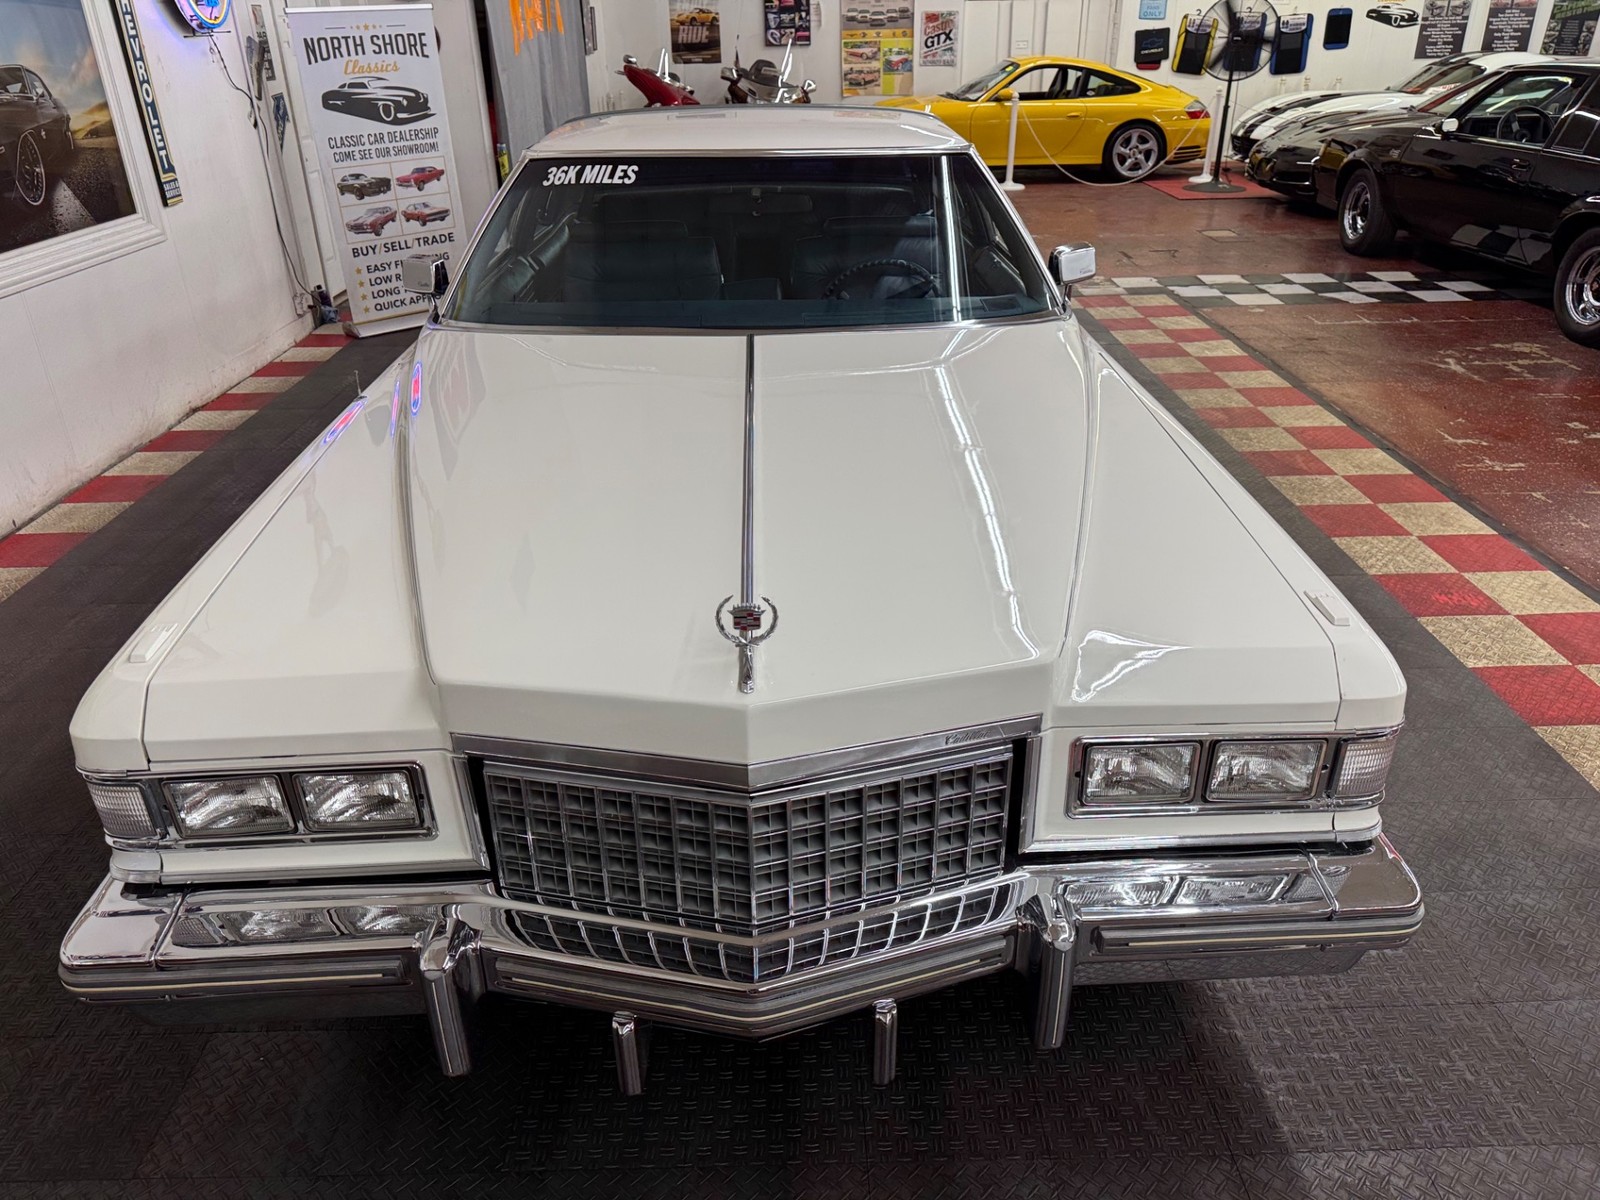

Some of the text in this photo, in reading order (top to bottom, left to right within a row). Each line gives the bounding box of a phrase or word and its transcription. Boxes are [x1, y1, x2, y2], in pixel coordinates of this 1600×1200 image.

[678, 25, 709, 44] RIDE
[924, 28, 954, 49] GTX
[303, 35, 366, 65] NORTH
[370, 32, 430, 58] SHORE
[343, 59, 400, 75] Classics
[119, 0, 169, 169] HEVROLET
[328, 127, 439, 149] CLASSIC CAR DEALERSHIP
[333, 141, 439, 163] COME SEE OUR SHOWROOM!
[542, 165, 639, 186] 36K MILES
[366, 261, 392, 274] EASY
[369, 275, 392, 287] LOW
[371, 286, 401, 299] LONG
[374, 299, 408, 311] QUICK
[945, 729, 992, 745] Cadillac
